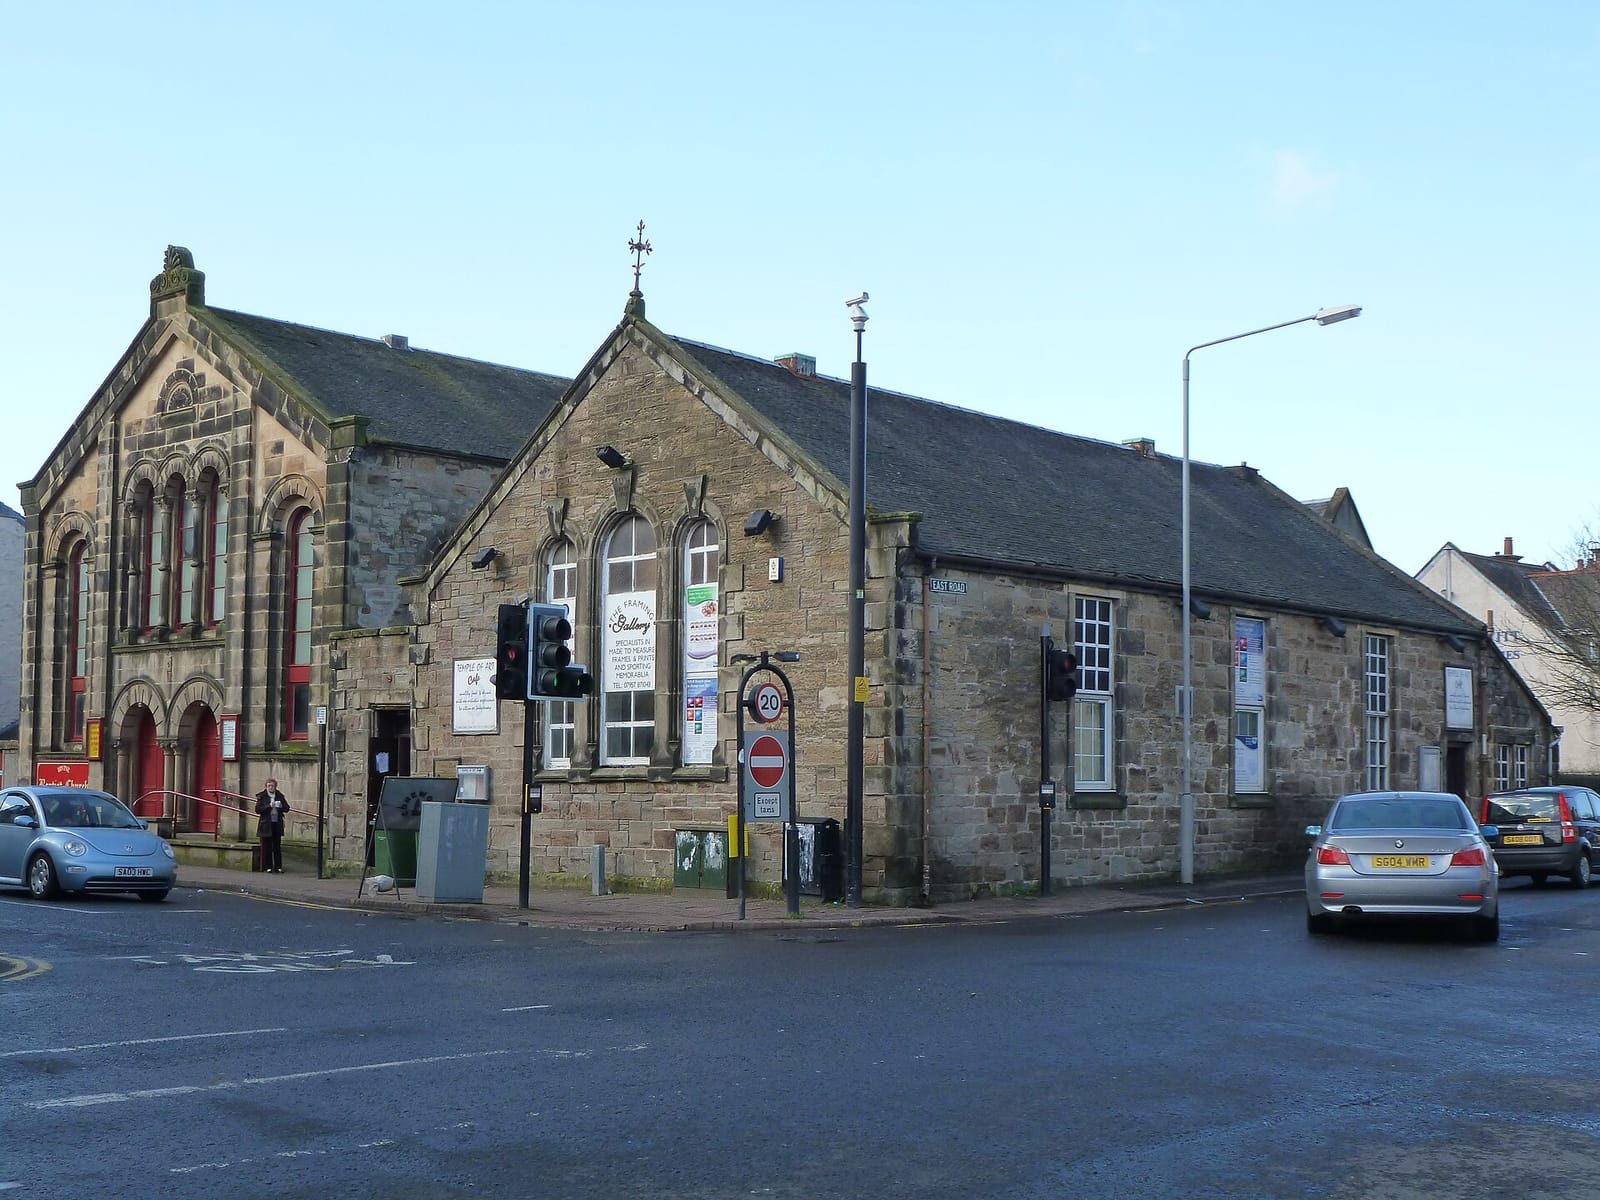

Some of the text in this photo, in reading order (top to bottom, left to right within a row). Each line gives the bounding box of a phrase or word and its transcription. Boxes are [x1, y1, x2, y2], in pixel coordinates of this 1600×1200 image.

[932, 580, 965, 593] EAST ROAD
[609, 600, 655, 623] THE FRAMING
[612, 614, 651, 635] Gallery
[615, 639, 644, 647] SPECIALISTS
[608, 647, 623, 655] MADE
[612, 655, 631, 663] FRAMES
[638, 654, 655, 662] PRINTS
[457, 661, 495, 673] TEMPLE OF ART
[615, 671, 649, 679] MEMORABILIA
[760, 695, 779, 710] 20
[757, 796, 778, 805] Except
[760, 805, 775, 813] taxis
[1376, 857, 1425, 867] SG04 WMR
[118, 868, 136, 876] SA03
